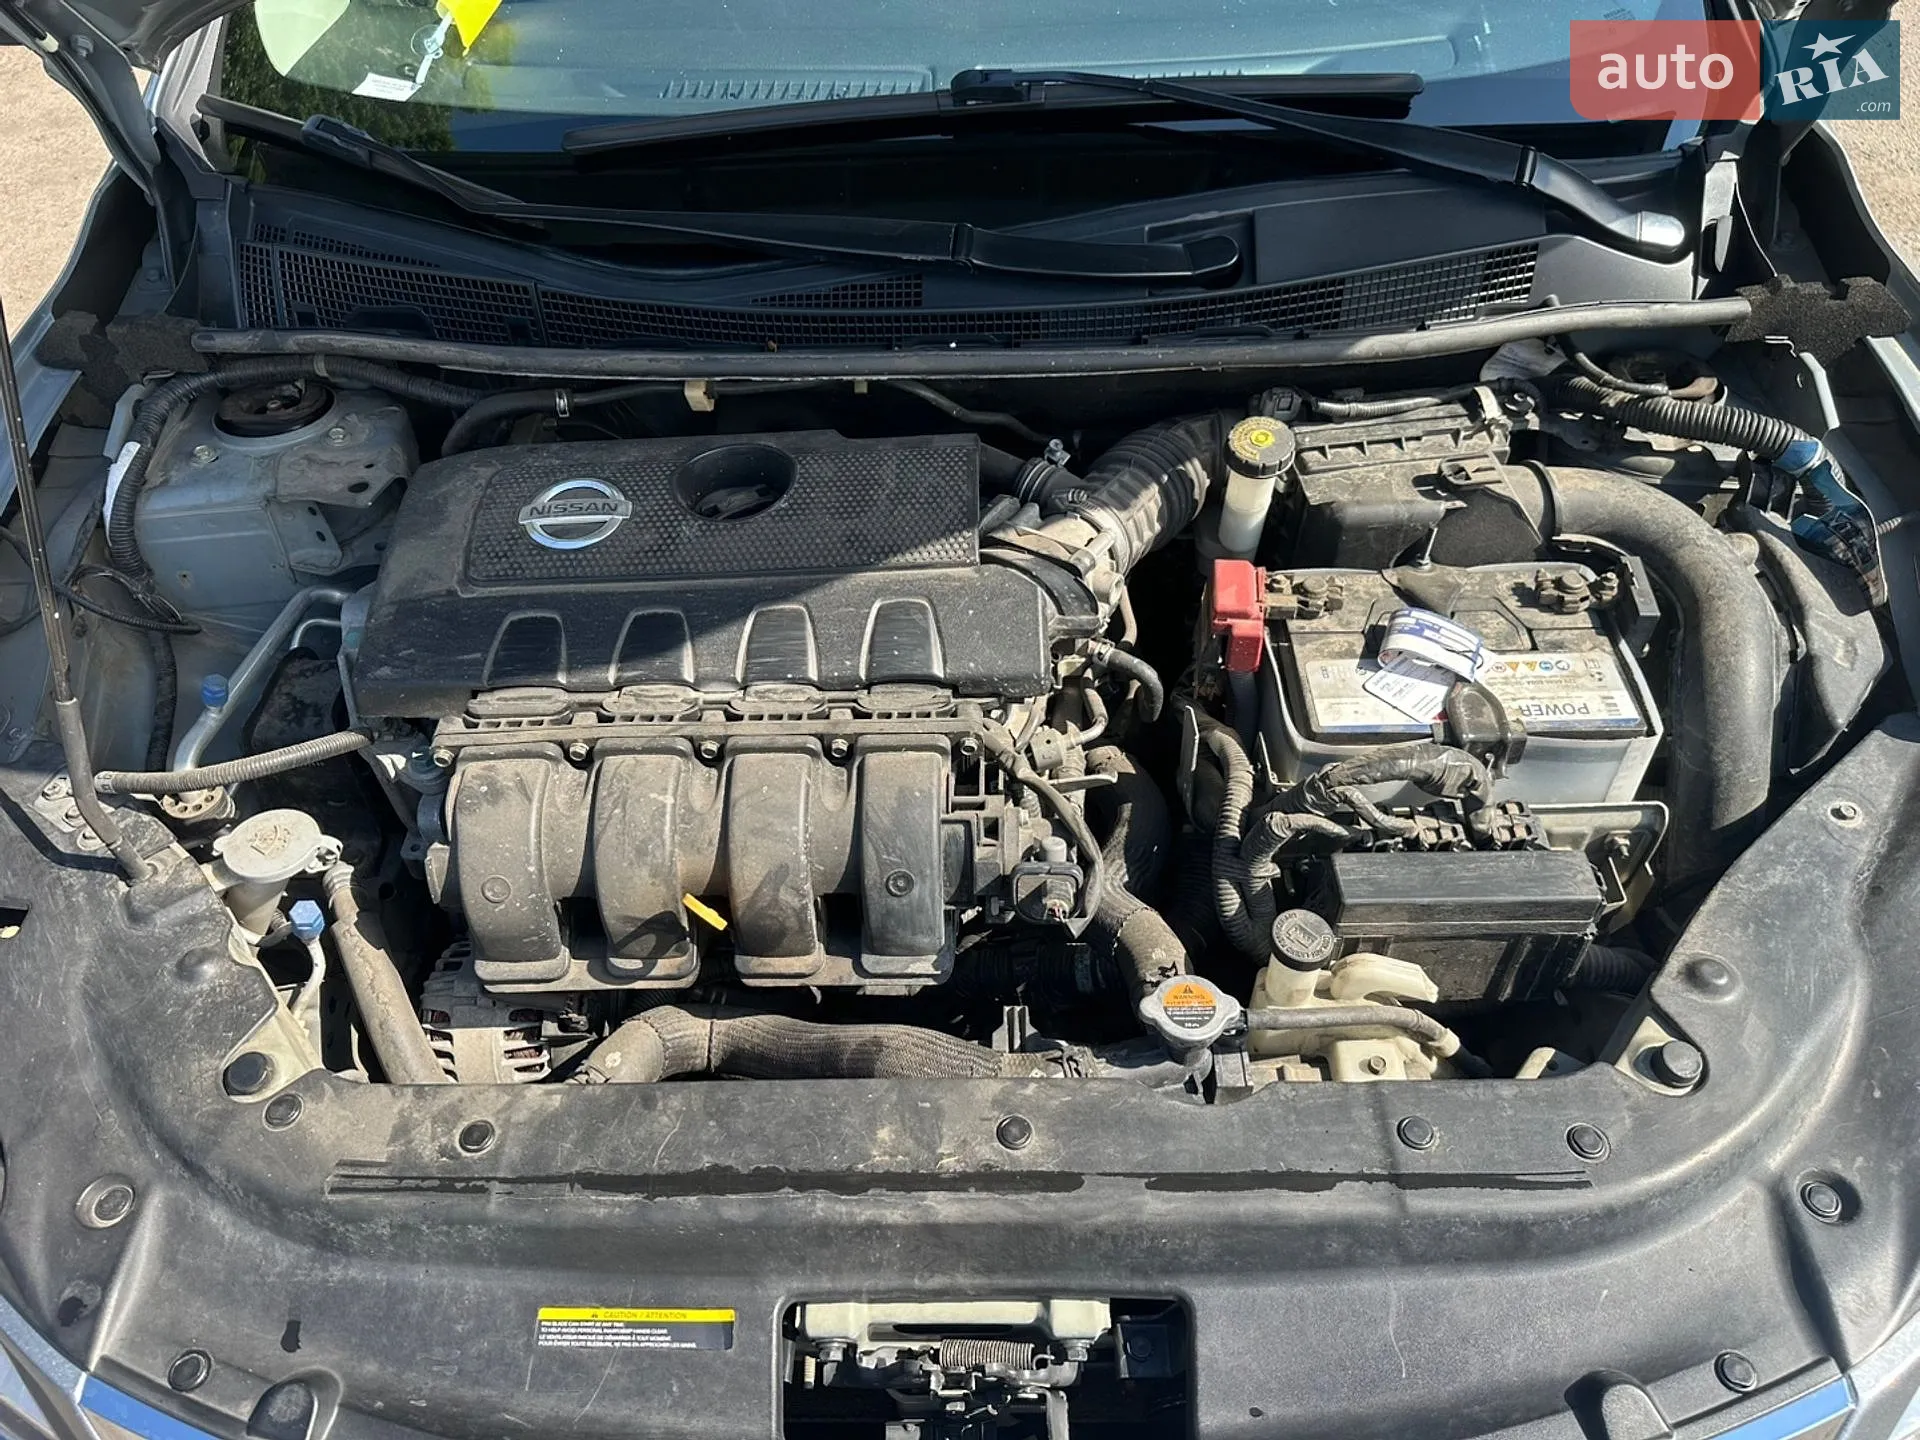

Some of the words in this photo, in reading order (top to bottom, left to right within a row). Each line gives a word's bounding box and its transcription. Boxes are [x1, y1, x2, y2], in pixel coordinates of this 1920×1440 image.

[529, 501, 618, 517] NISSAN
[1519, 702, 1591, 717] POWER
[603, 1311, 638, 1319] CAUTION
[645, 1312, 688, 1320] ATTENTION
